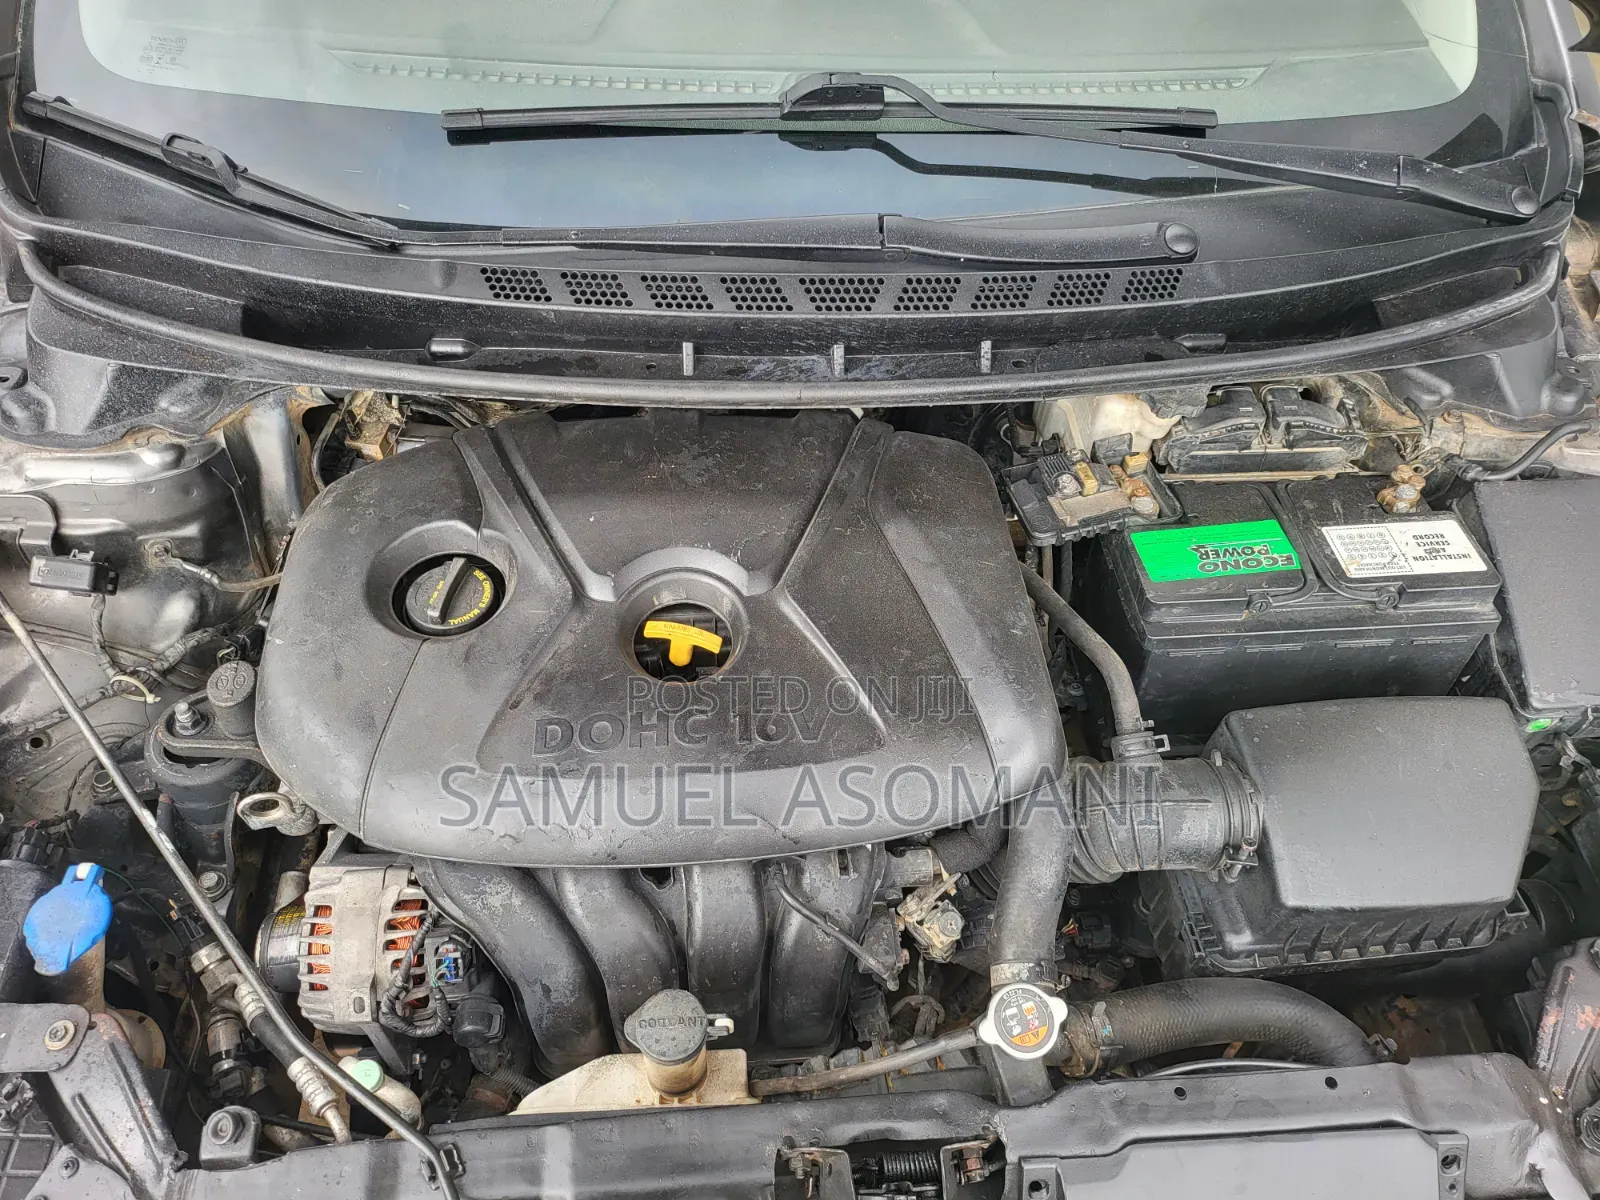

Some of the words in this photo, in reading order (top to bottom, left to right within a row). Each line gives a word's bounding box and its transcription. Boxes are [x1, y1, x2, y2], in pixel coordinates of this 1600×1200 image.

[1412, 533, 1446, 541] RECORD
[1415, 540, 1451, 548] SERVICE
[1198, 543, 1271, 561] POWER
[1412, 553, 1472, 562] INSTALLATION
[1198, 553, 1296, 574] ECONO
[473, 570, 486, 581] SEE
[478, 581, 491, 608] OWNER'S
[448, 608, 480, 625] MANUAL
[532, 708, 708, 757] DOHC
[730, 706, 832, 745] 16V
[638, 1015, 706, 1030] COOLANT
